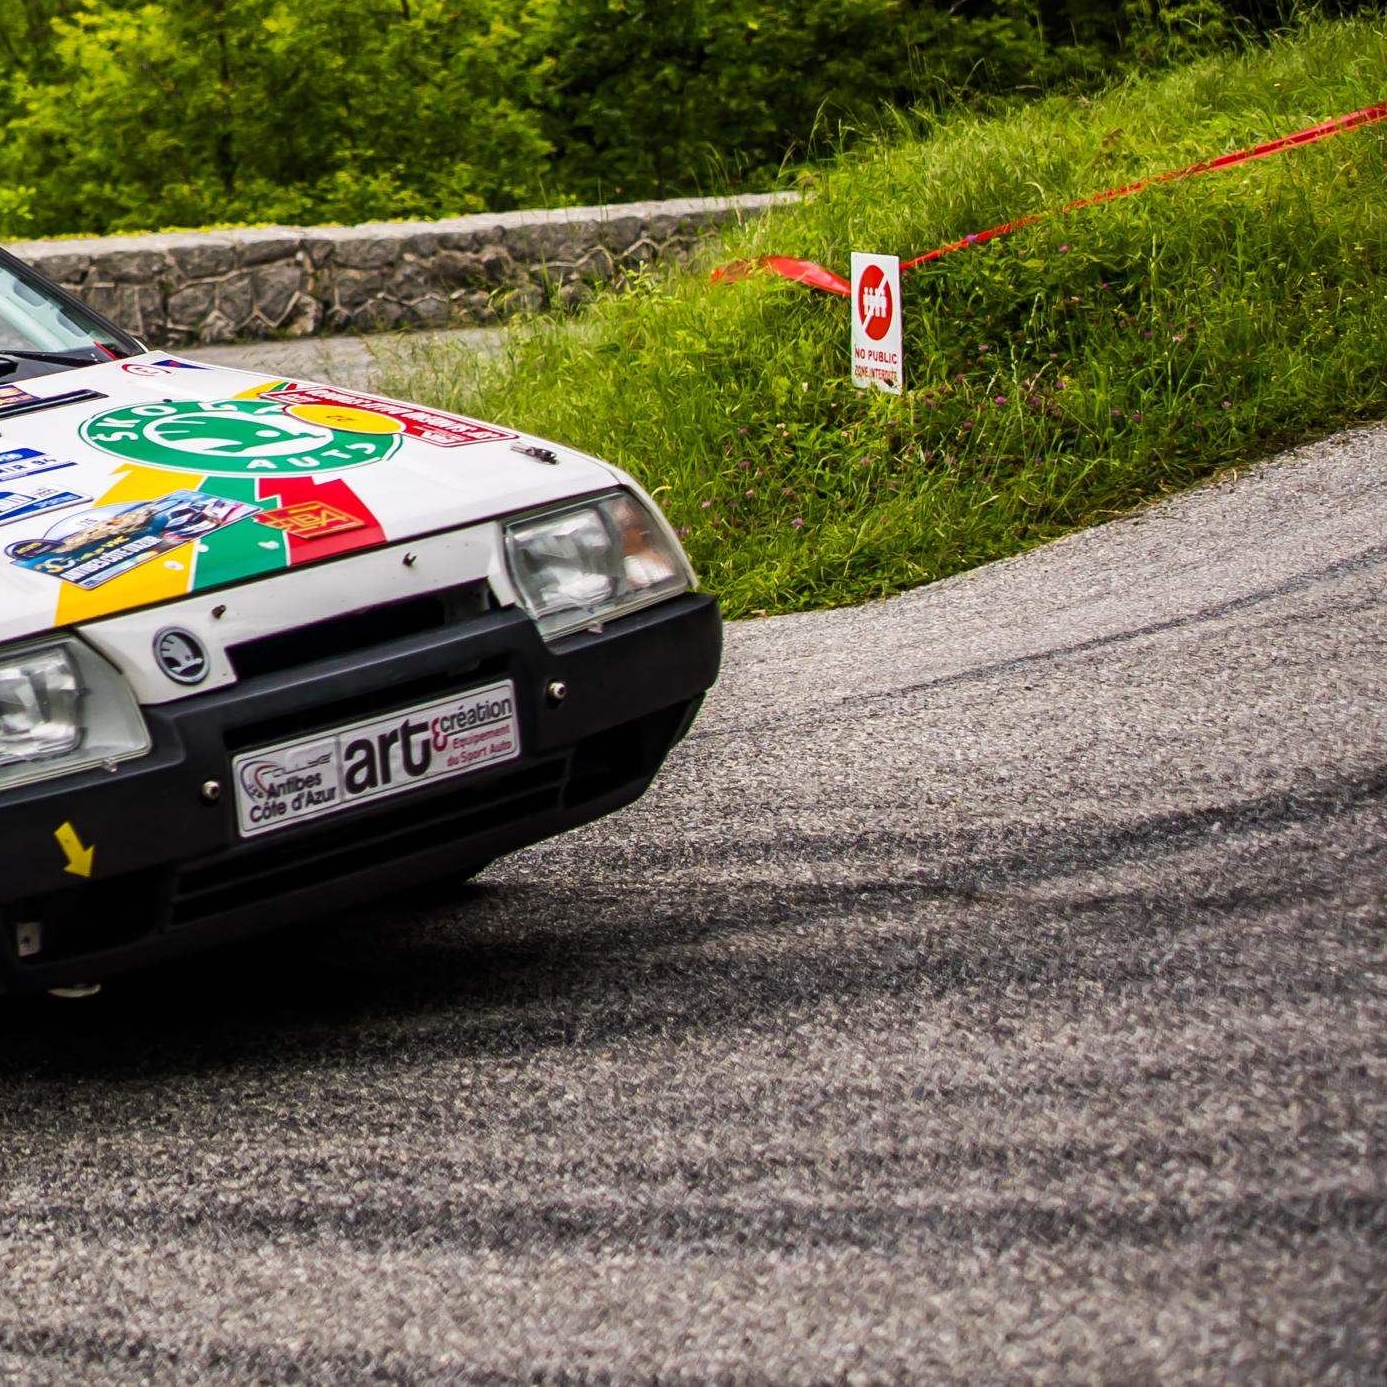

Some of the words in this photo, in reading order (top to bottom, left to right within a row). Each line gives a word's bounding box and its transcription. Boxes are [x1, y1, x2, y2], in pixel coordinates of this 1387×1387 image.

[855, 347, 865, 359] NO
[868, 350, 897, 364] PUBLIC
[343, 719, 433, 796] art
[440, 697, 512, 733] création
[460, 747, 487, 764] Sport
[490, 740, 512, 754] Auto
[249, 800, 287, 823] Côte
[292, 787, 336, 812] d'Azur
